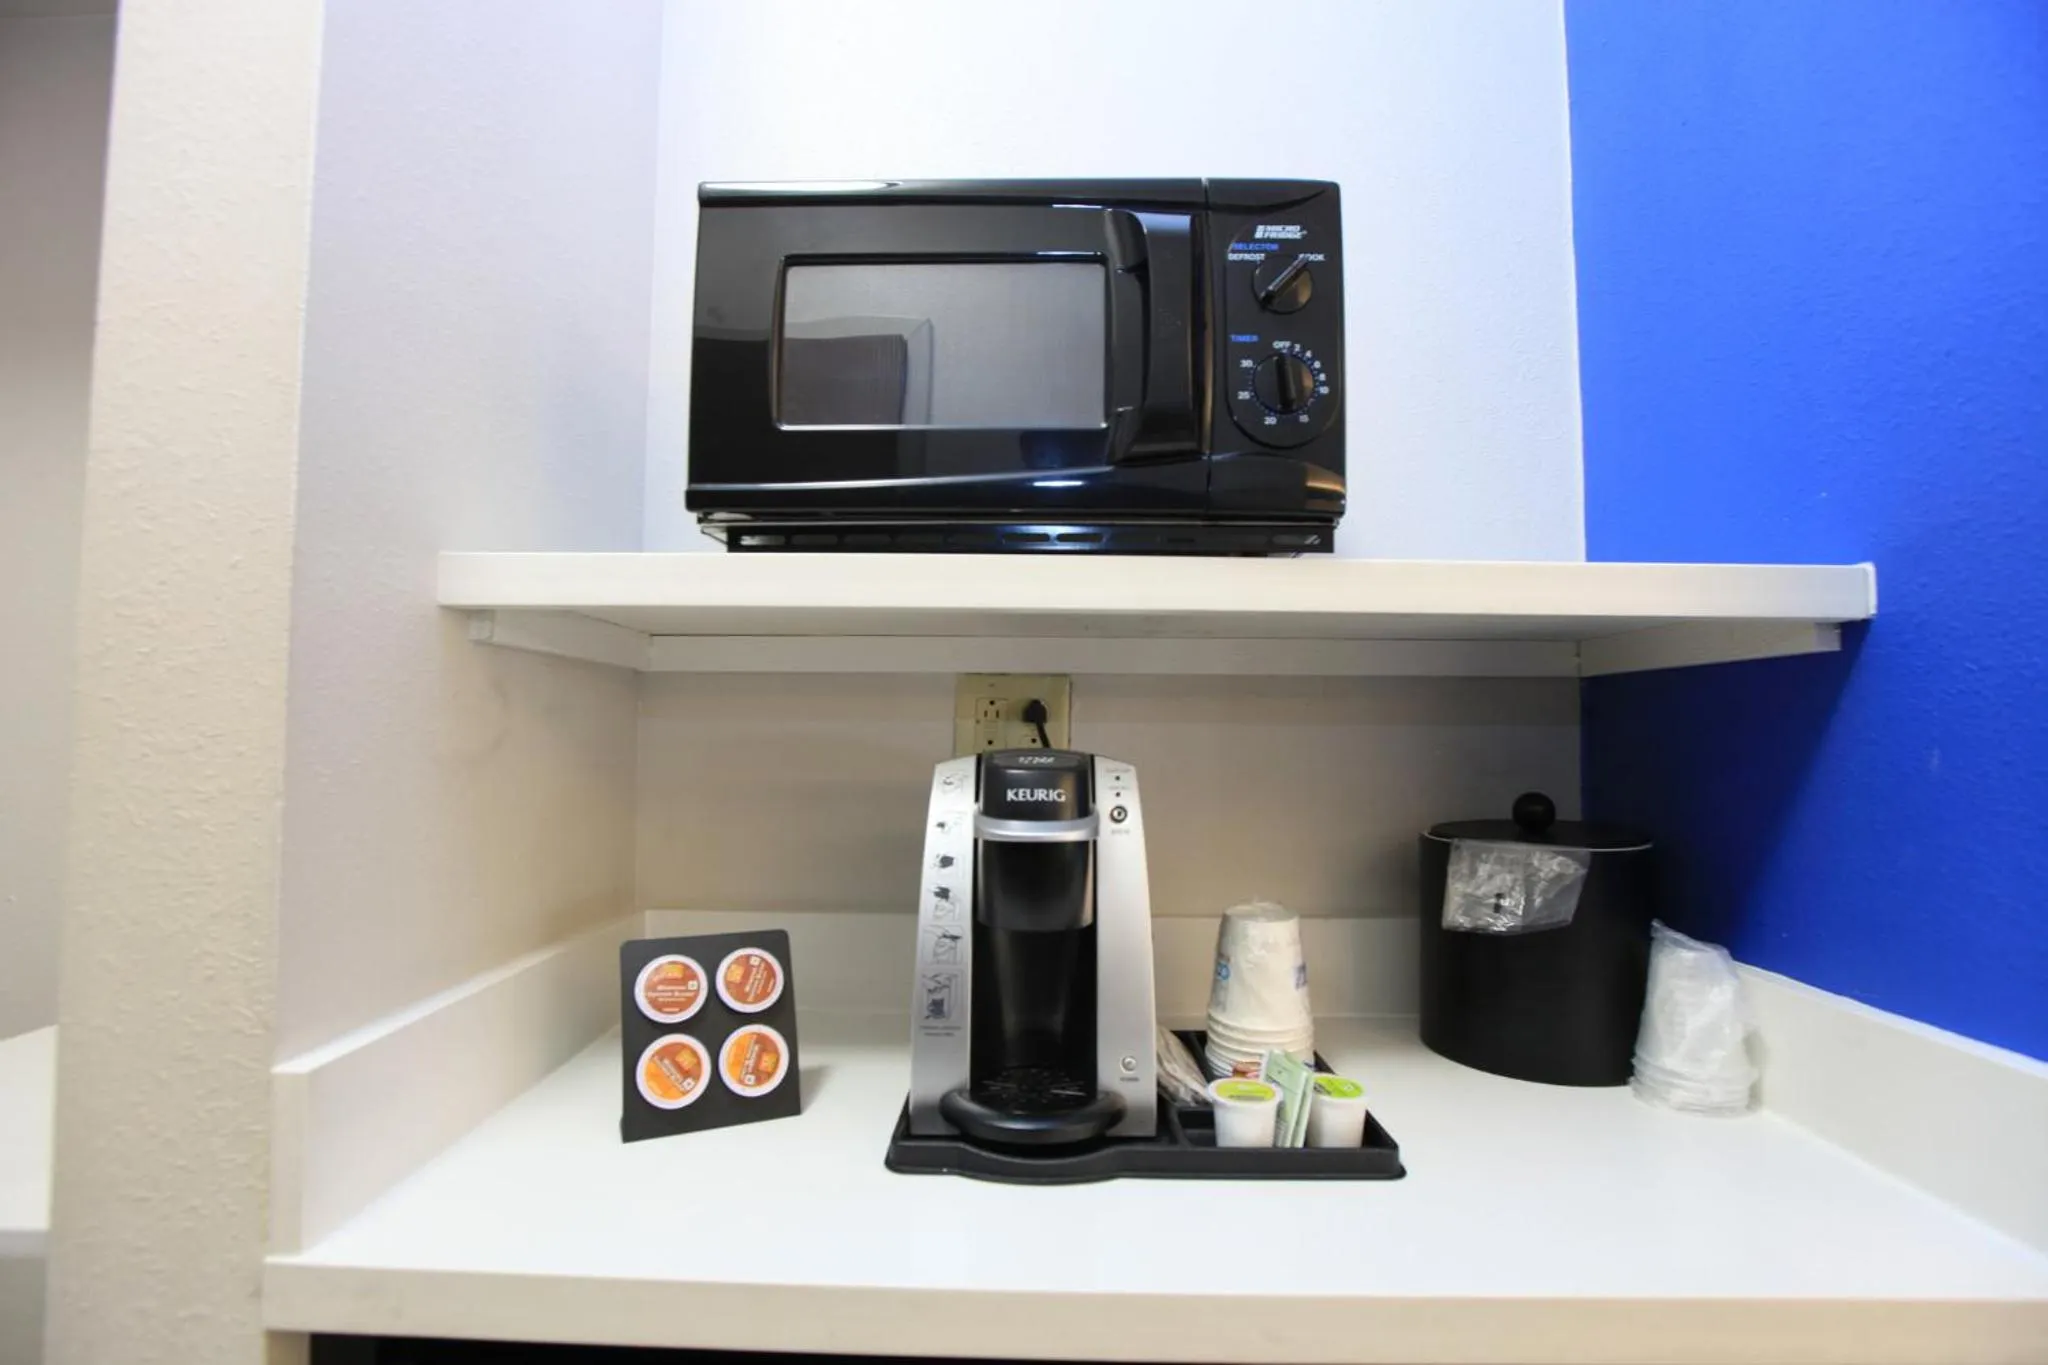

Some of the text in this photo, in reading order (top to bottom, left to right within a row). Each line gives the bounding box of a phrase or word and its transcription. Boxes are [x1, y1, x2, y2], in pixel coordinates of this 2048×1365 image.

[1231, 242, 1279, 250] SELECTOR
[1227, 253, 1265, 261] DEFROST
[1231, 334, 1258, 342] TIMER
[1272, 341, 1292, 349] OFF
[1294, 343, 1301, 352] 2
[1305, 350, 1312, 358] 4
[1240, 359, 1253, 368] 30
[1319, 386, 1329, 395] 10
[1237, 391, 1251, 400] 25
[1264, 416, 1277, 425] 20
[1006, 788, 1066, 802] KEURIG
